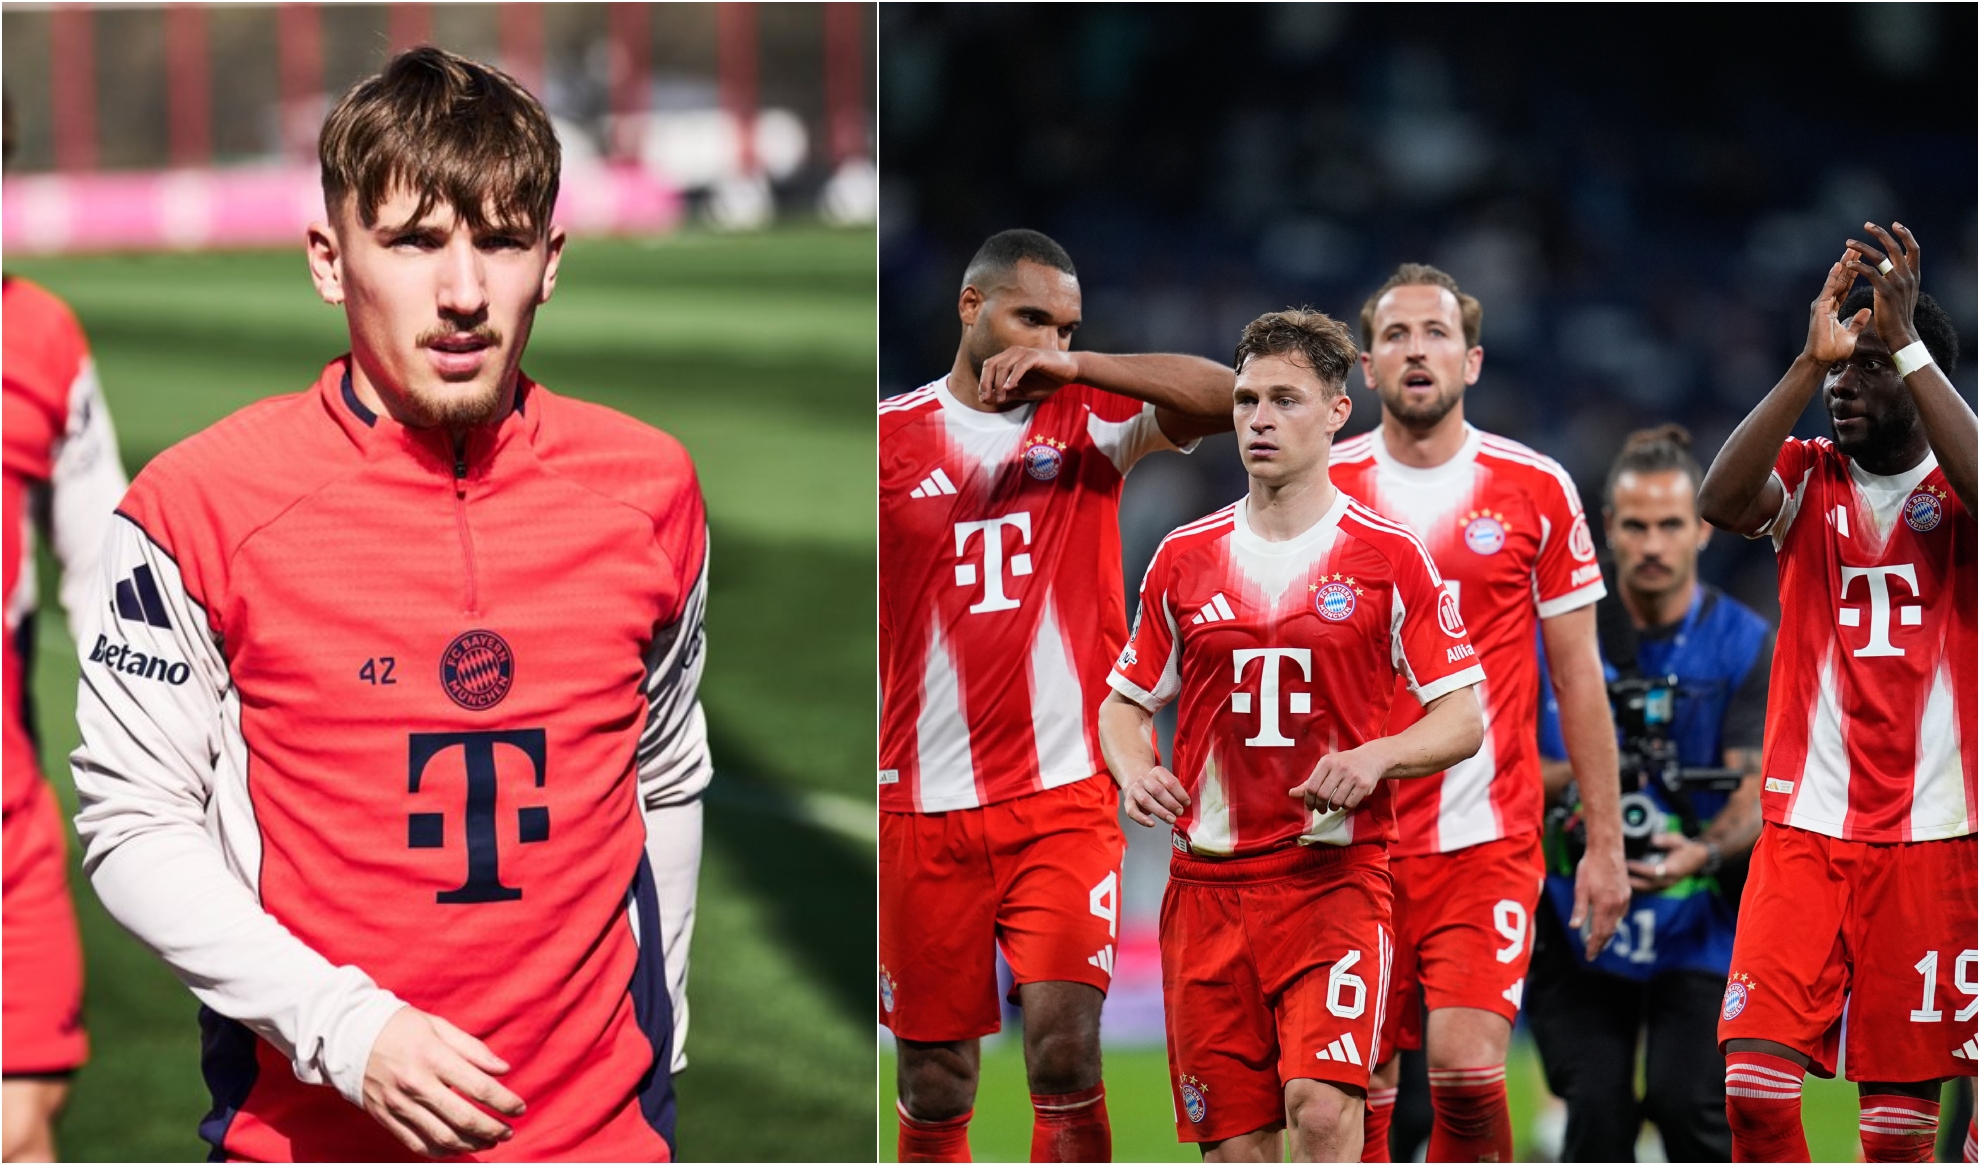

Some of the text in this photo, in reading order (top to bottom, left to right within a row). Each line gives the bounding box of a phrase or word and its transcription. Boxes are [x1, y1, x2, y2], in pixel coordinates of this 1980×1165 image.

[1912, 496, 1938, 508] BAYERN
[953, 511, 1033, 615] T
[1319, 585, 1353, 601] FC BAYERN
[1838, 563, 1922, 658] T
[88, 633, 190, 685] Betano
[359, 657, 397, 686] 42
[446, 634, 509, 667] FC BAYERN
[1231, 648, 1311, 747] T
[407, 729, 550, 905] T
[1089, 869, 1117, 939] 4
[1493, 898, 1527, 965] 9
[1326, 949, 1367, 1020] 6
[1909, 949, 1978, 1022] 19
